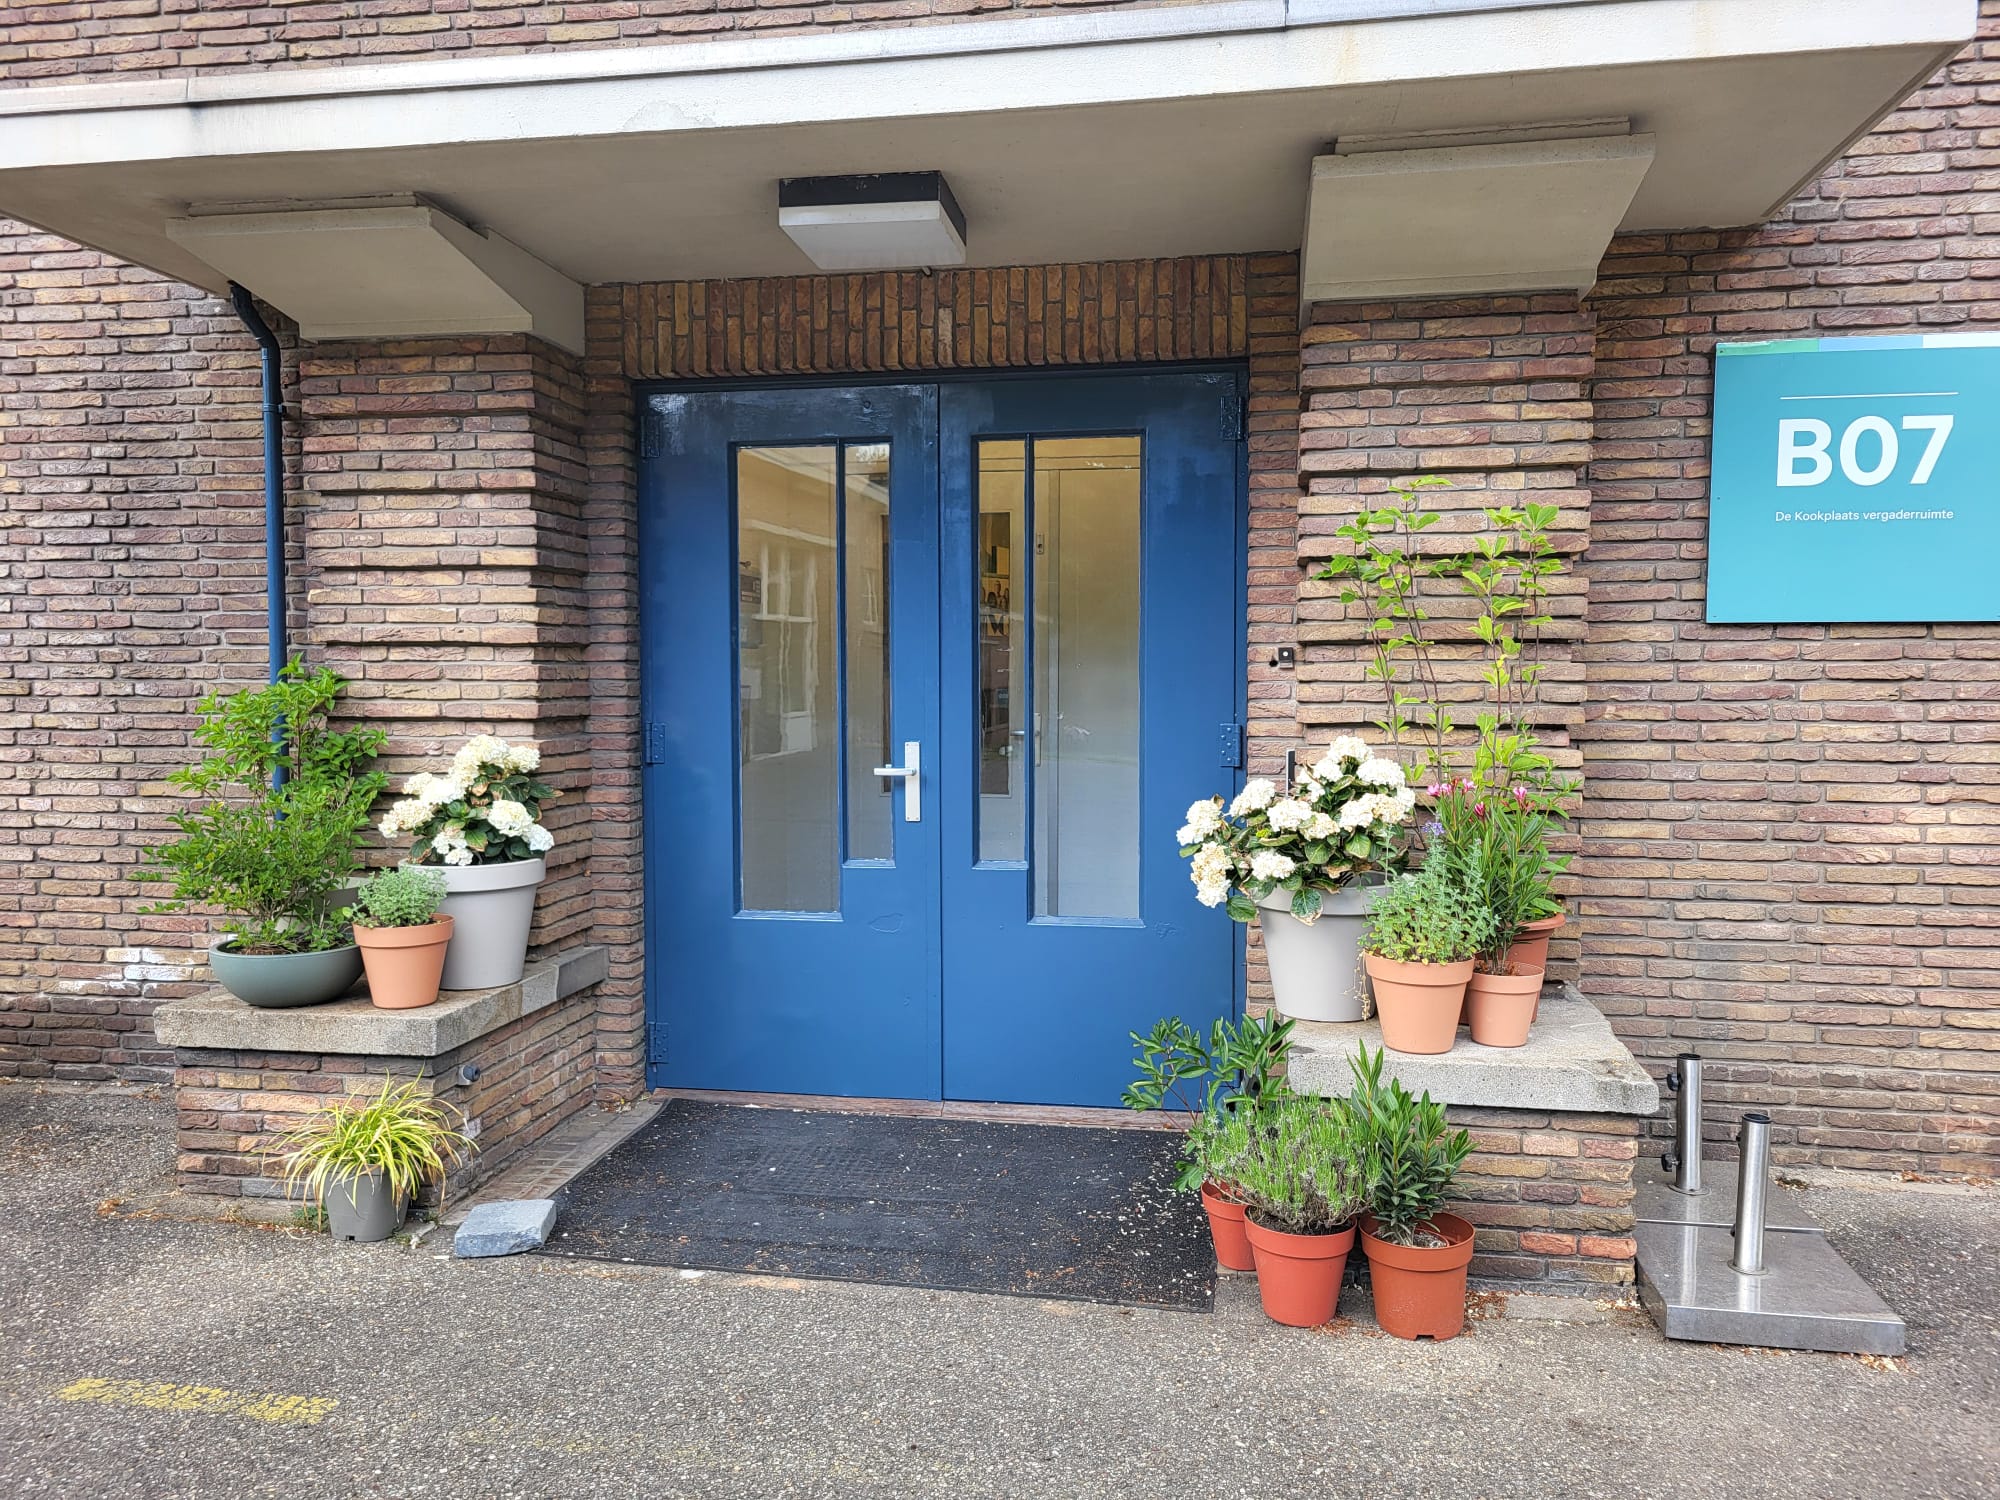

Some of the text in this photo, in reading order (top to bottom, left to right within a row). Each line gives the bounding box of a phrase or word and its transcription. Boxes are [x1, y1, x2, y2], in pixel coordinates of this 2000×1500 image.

[1776, 414, 1955, 487] B07
[1775, 509, 1954, 523] De Kookplaats vergaderruimte
